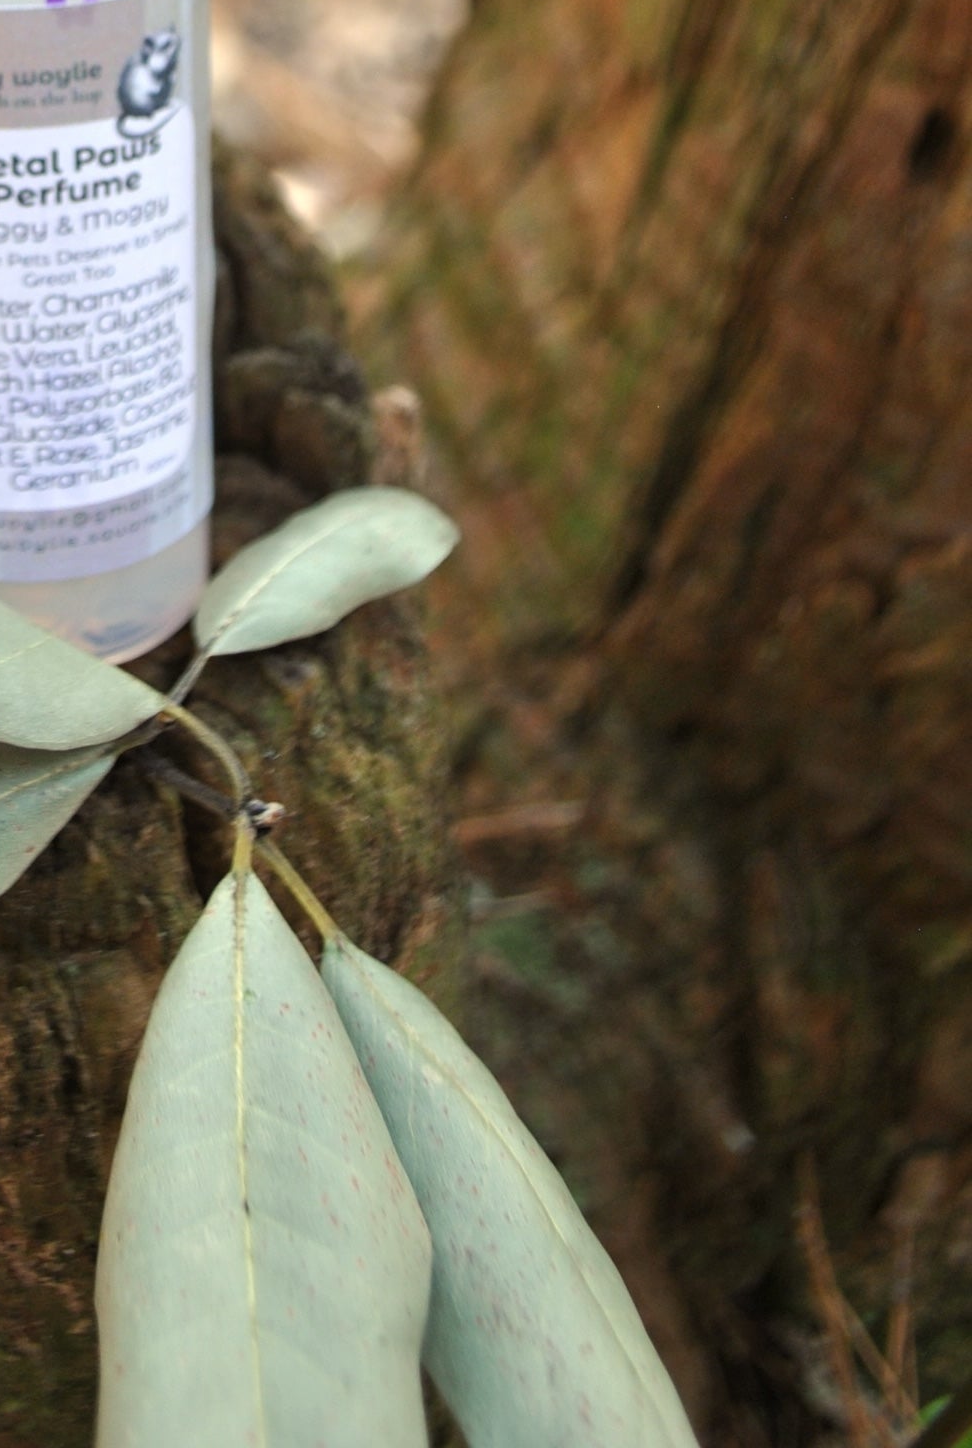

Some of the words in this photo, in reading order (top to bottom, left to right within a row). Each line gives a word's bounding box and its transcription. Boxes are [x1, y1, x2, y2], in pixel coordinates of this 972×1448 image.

[12, 60, 103, 89] woylie
[72, 133, 163, 173] Paws
[54, 216, 73, 236] &
[81, 197, 171, 233] Moggy
[8, 251, 51, 267] Pets
[56, 240, 128, 266] Deserve
[22, 268, 78, 289] Great
[40, 265, 180, 318] Chamomile
[9, 456, 140, 492] Geranium
